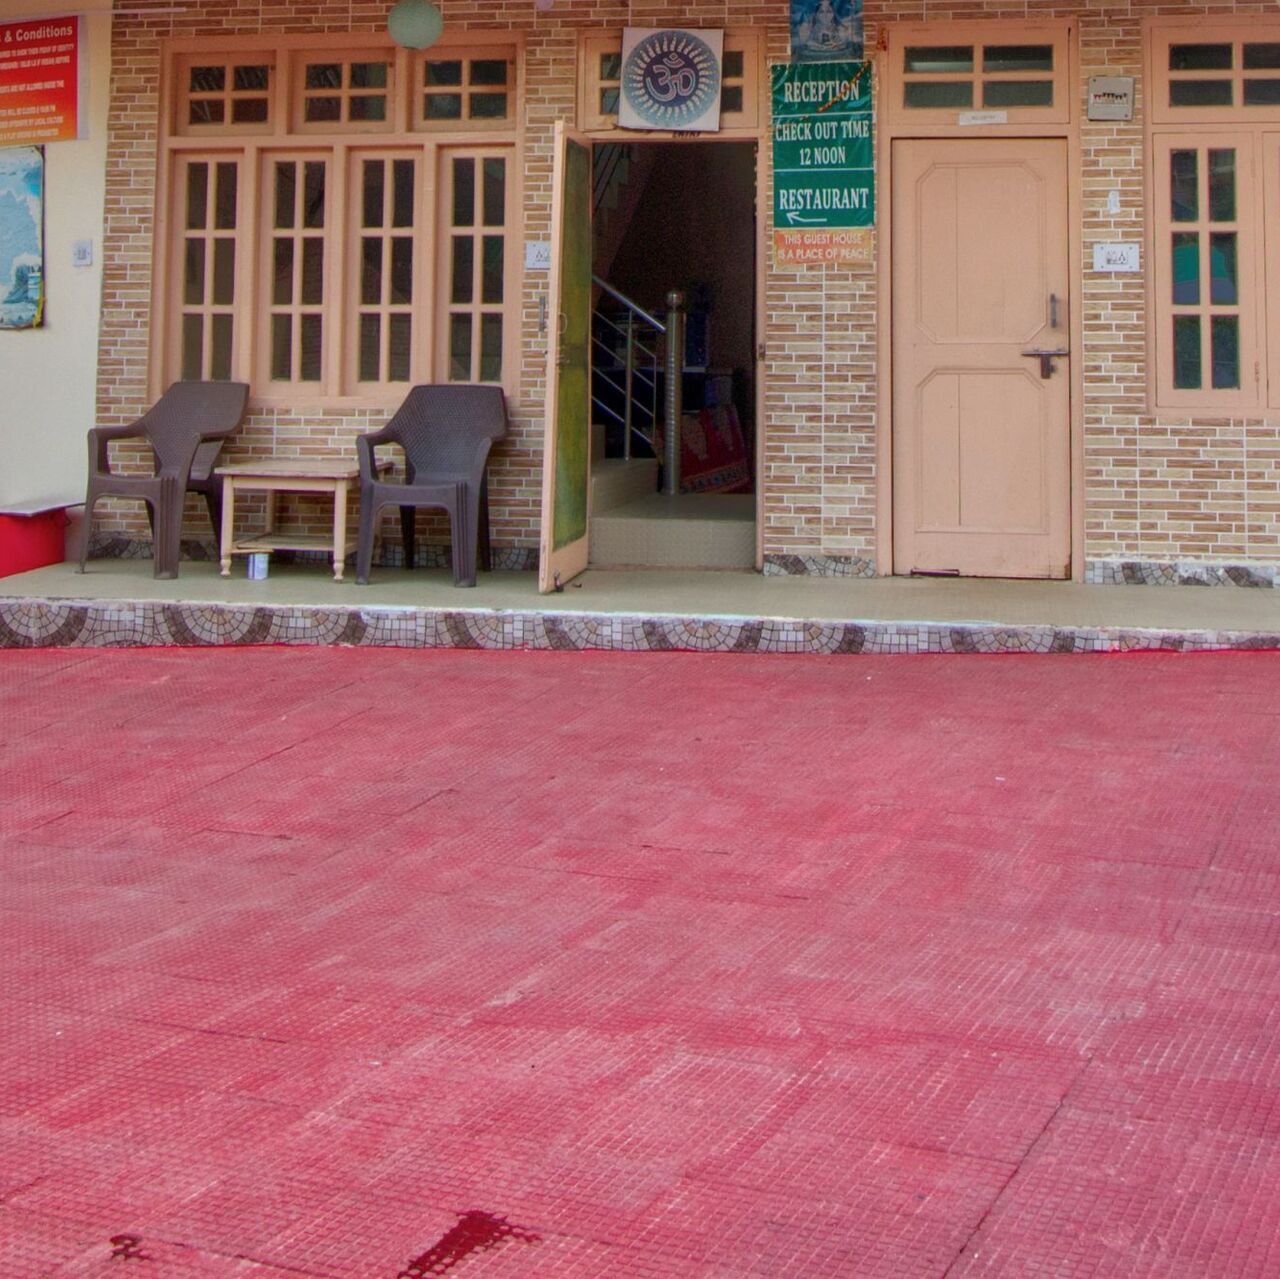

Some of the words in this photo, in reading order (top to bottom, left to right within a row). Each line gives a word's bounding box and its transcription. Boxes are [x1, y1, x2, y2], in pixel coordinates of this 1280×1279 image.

[4, 30, 13, 43] &
[16, 25, 73, 41] Conditions
[784, 80, 860, 103] RECEPTION
[775, 122, 813, 142] CHECK
[814, 121, 838, 140] OUT
[841, 120, 870, 139] TIME
[799, 148, 812, 165] 12
[814, 146, 846, 165] NOON
[779, 187, 870, 210] RESTAURANT
[784, 233, 802, 245] THIS
[803, 233, 831, 245] GUEST
[832, 233, 862, 245] HOUSE
[787, 249, 794, 260] A
[796, 248, 824, 260] PLACE
[825, 248, 839, 259] OF
[840, 247, 869, 259] PEACE
